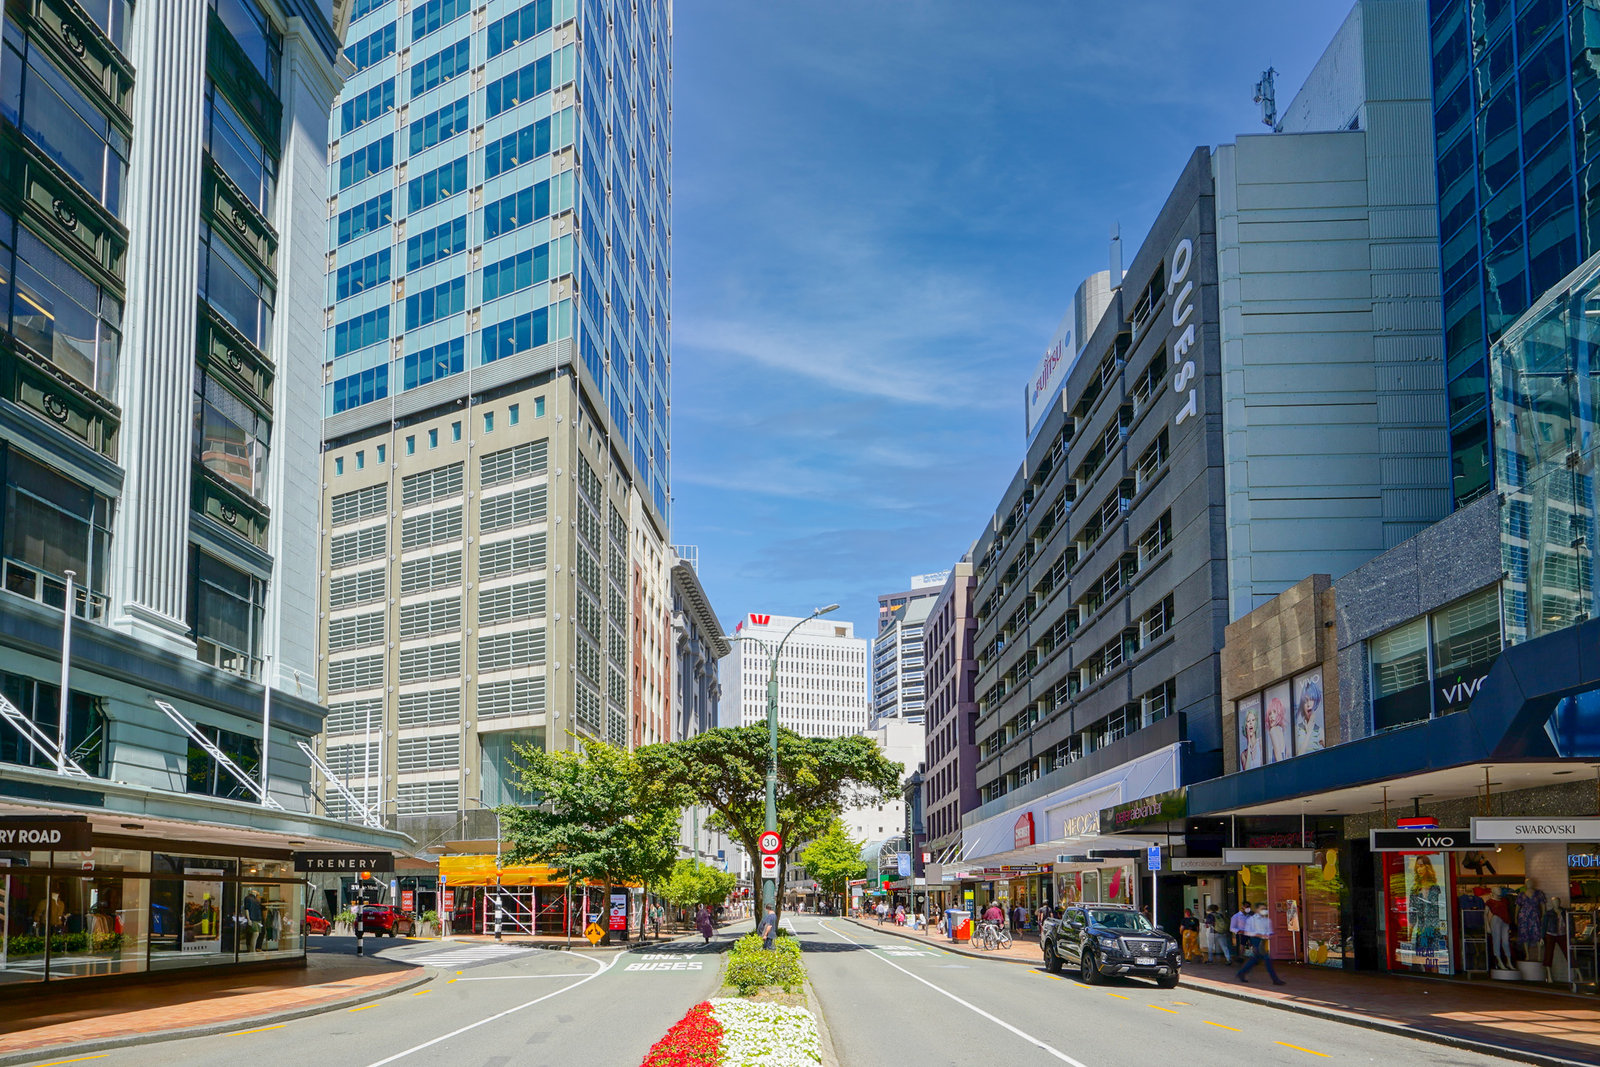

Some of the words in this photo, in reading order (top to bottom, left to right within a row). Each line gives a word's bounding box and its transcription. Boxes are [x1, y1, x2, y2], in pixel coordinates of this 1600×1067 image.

[1168, 238, 1197, 425] QUEST
[1515, 825, 1576, 834] SWAROVSKI
[18, 830, 61, 843] ROAD
[764, 838, 777, 847] 30
[307, 859, 377, 868] TRENERY
[624, 961, 703, 971] BUSES
